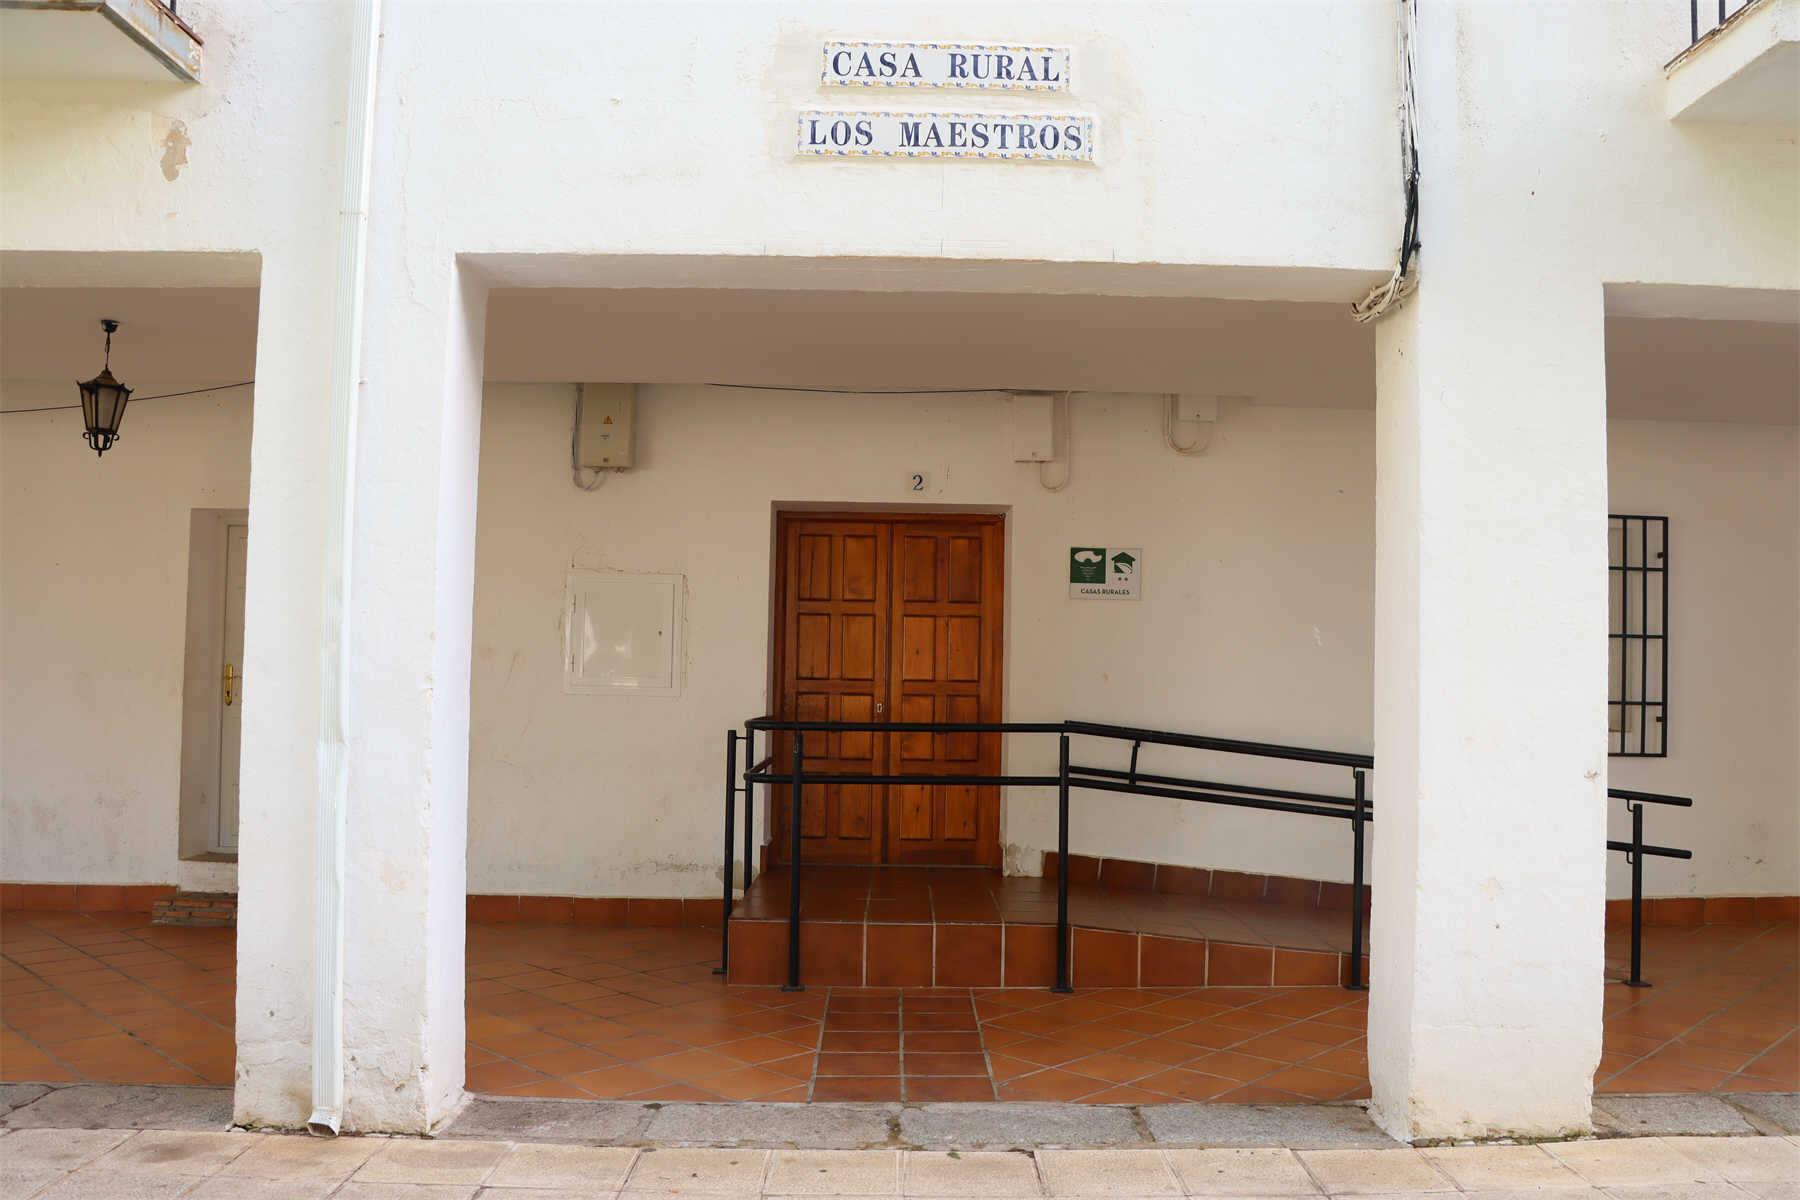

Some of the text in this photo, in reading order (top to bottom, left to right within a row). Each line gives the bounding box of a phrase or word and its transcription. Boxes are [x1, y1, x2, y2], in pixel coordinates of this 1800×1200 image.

[832, 51, 1060, 82] CASA RURAL
[808, 119, 1082, 151] LOS MAESTROS
[913, 475, 923, 490] 2
